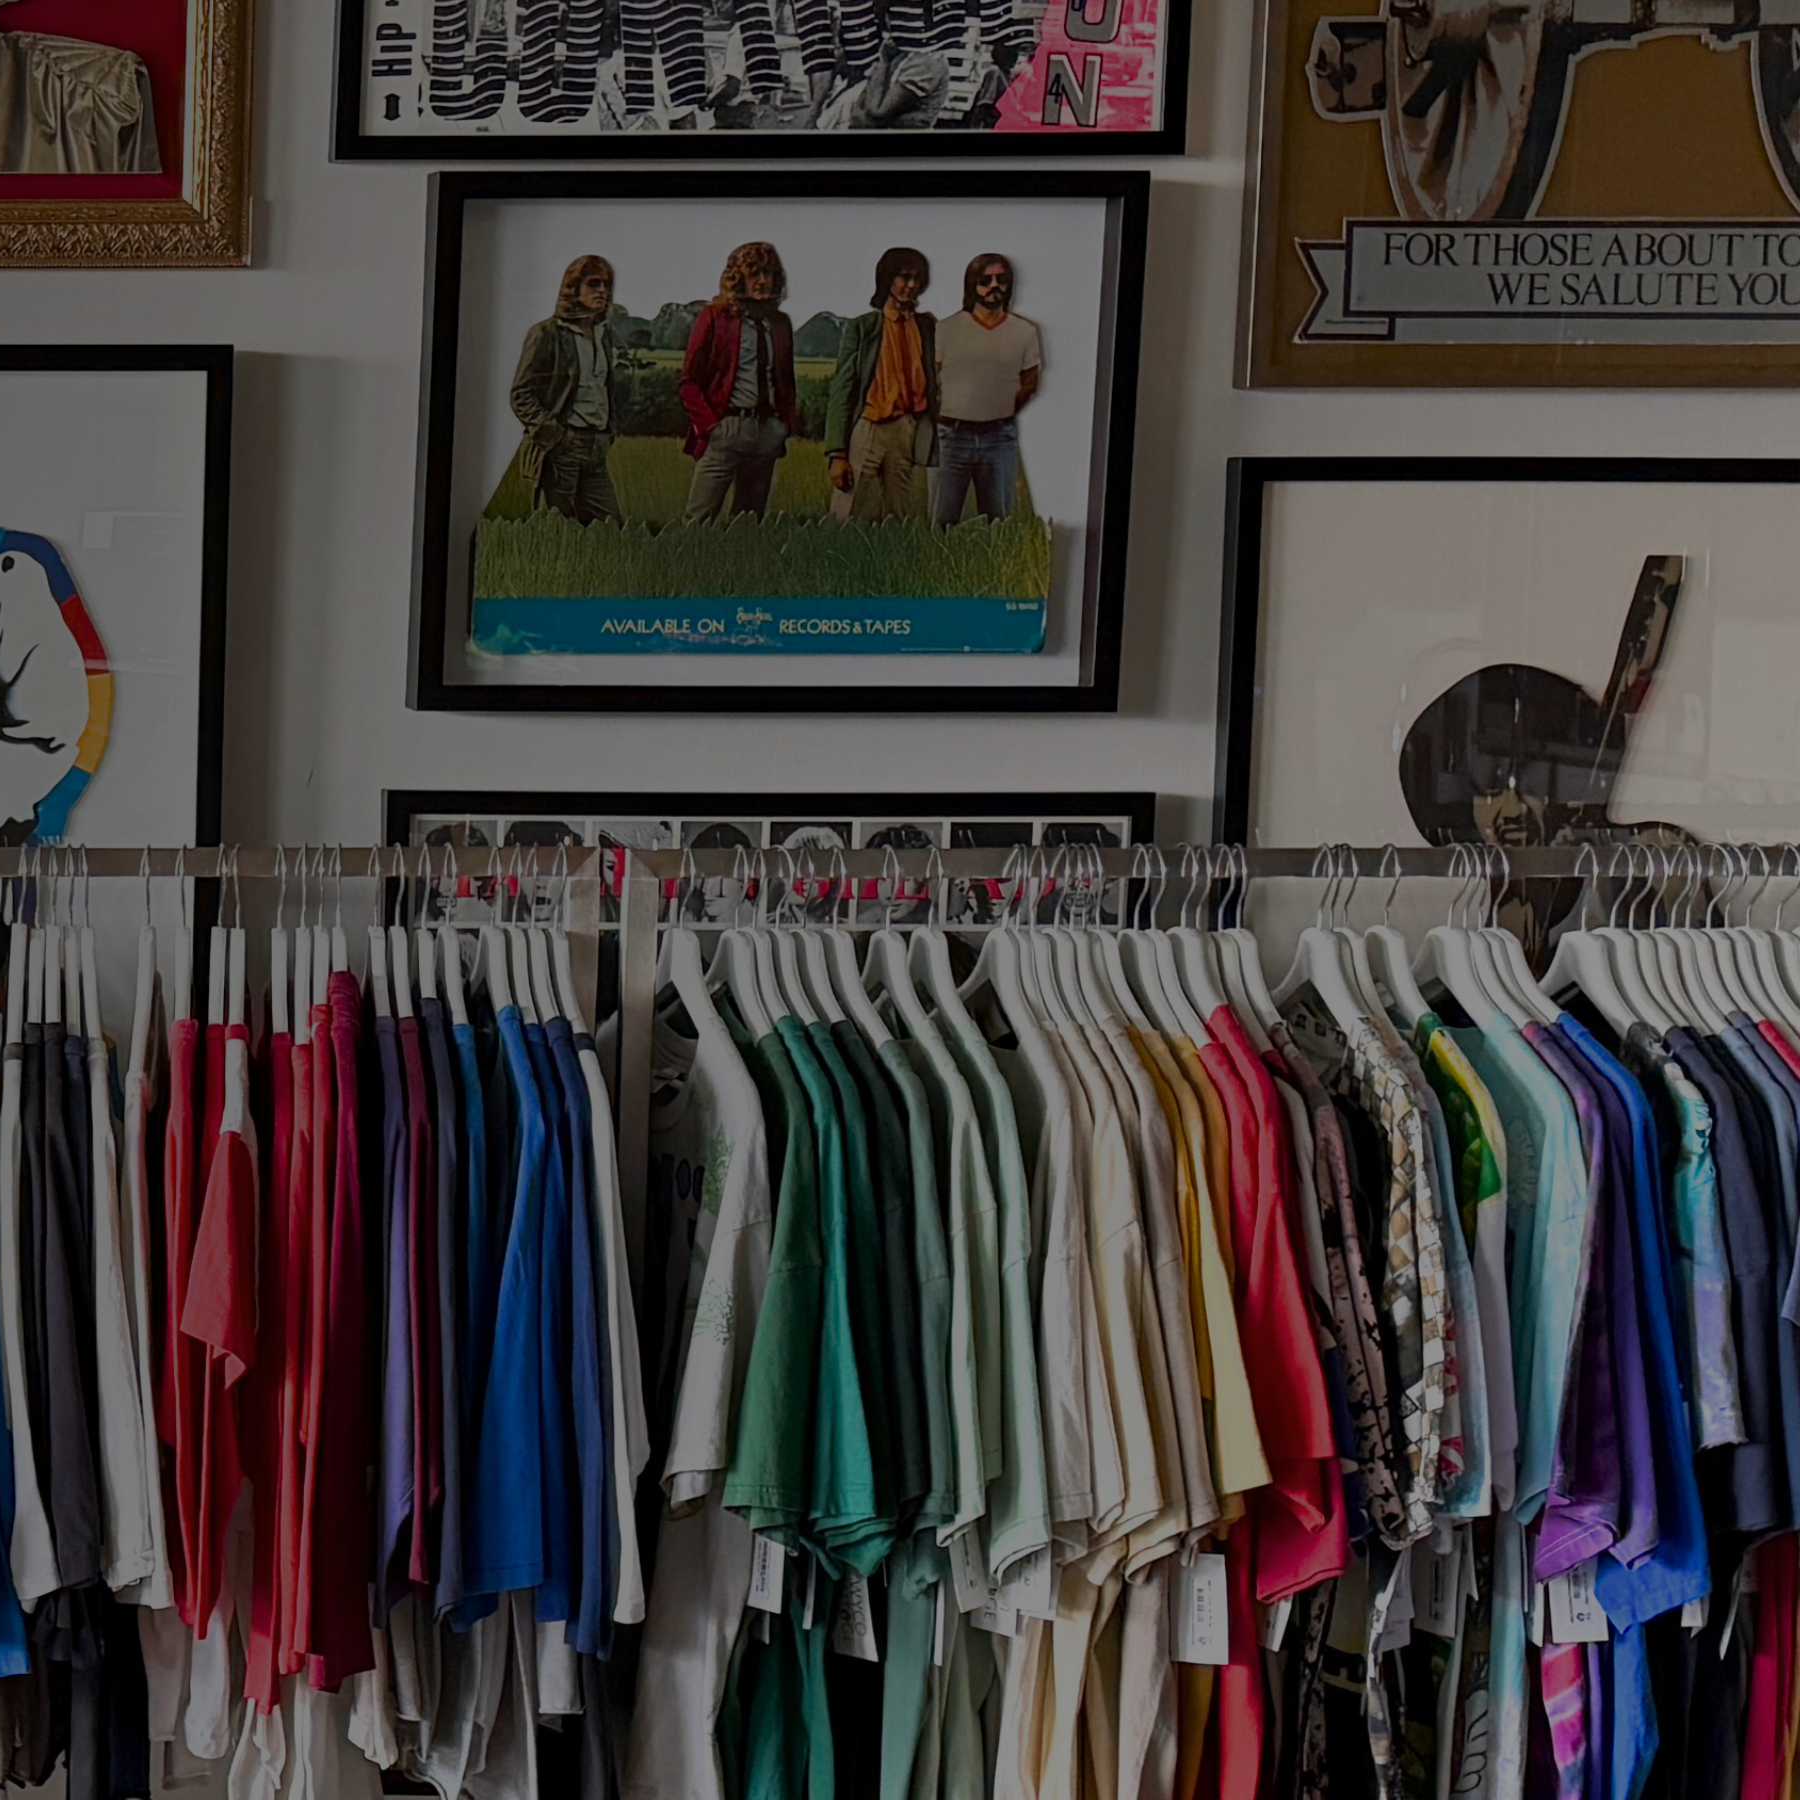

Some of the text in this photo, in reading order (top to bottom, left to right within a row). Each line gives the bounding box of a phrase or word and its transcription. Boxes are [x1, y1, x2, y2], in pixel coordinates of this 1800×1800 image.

[372, 23, 417, 77] HIP
[1383, 232, 1800, 267] FOR THOSE ABOUT TO
[1486, 272, 1800, 306] WE SALUTE YOU
[600, 618, 691, 635] AVAILABLE
[696, 617, 725, 635] ON
[778, 618, 851, 636] RECORDS
[863, 618, 912, 636] TAPES
